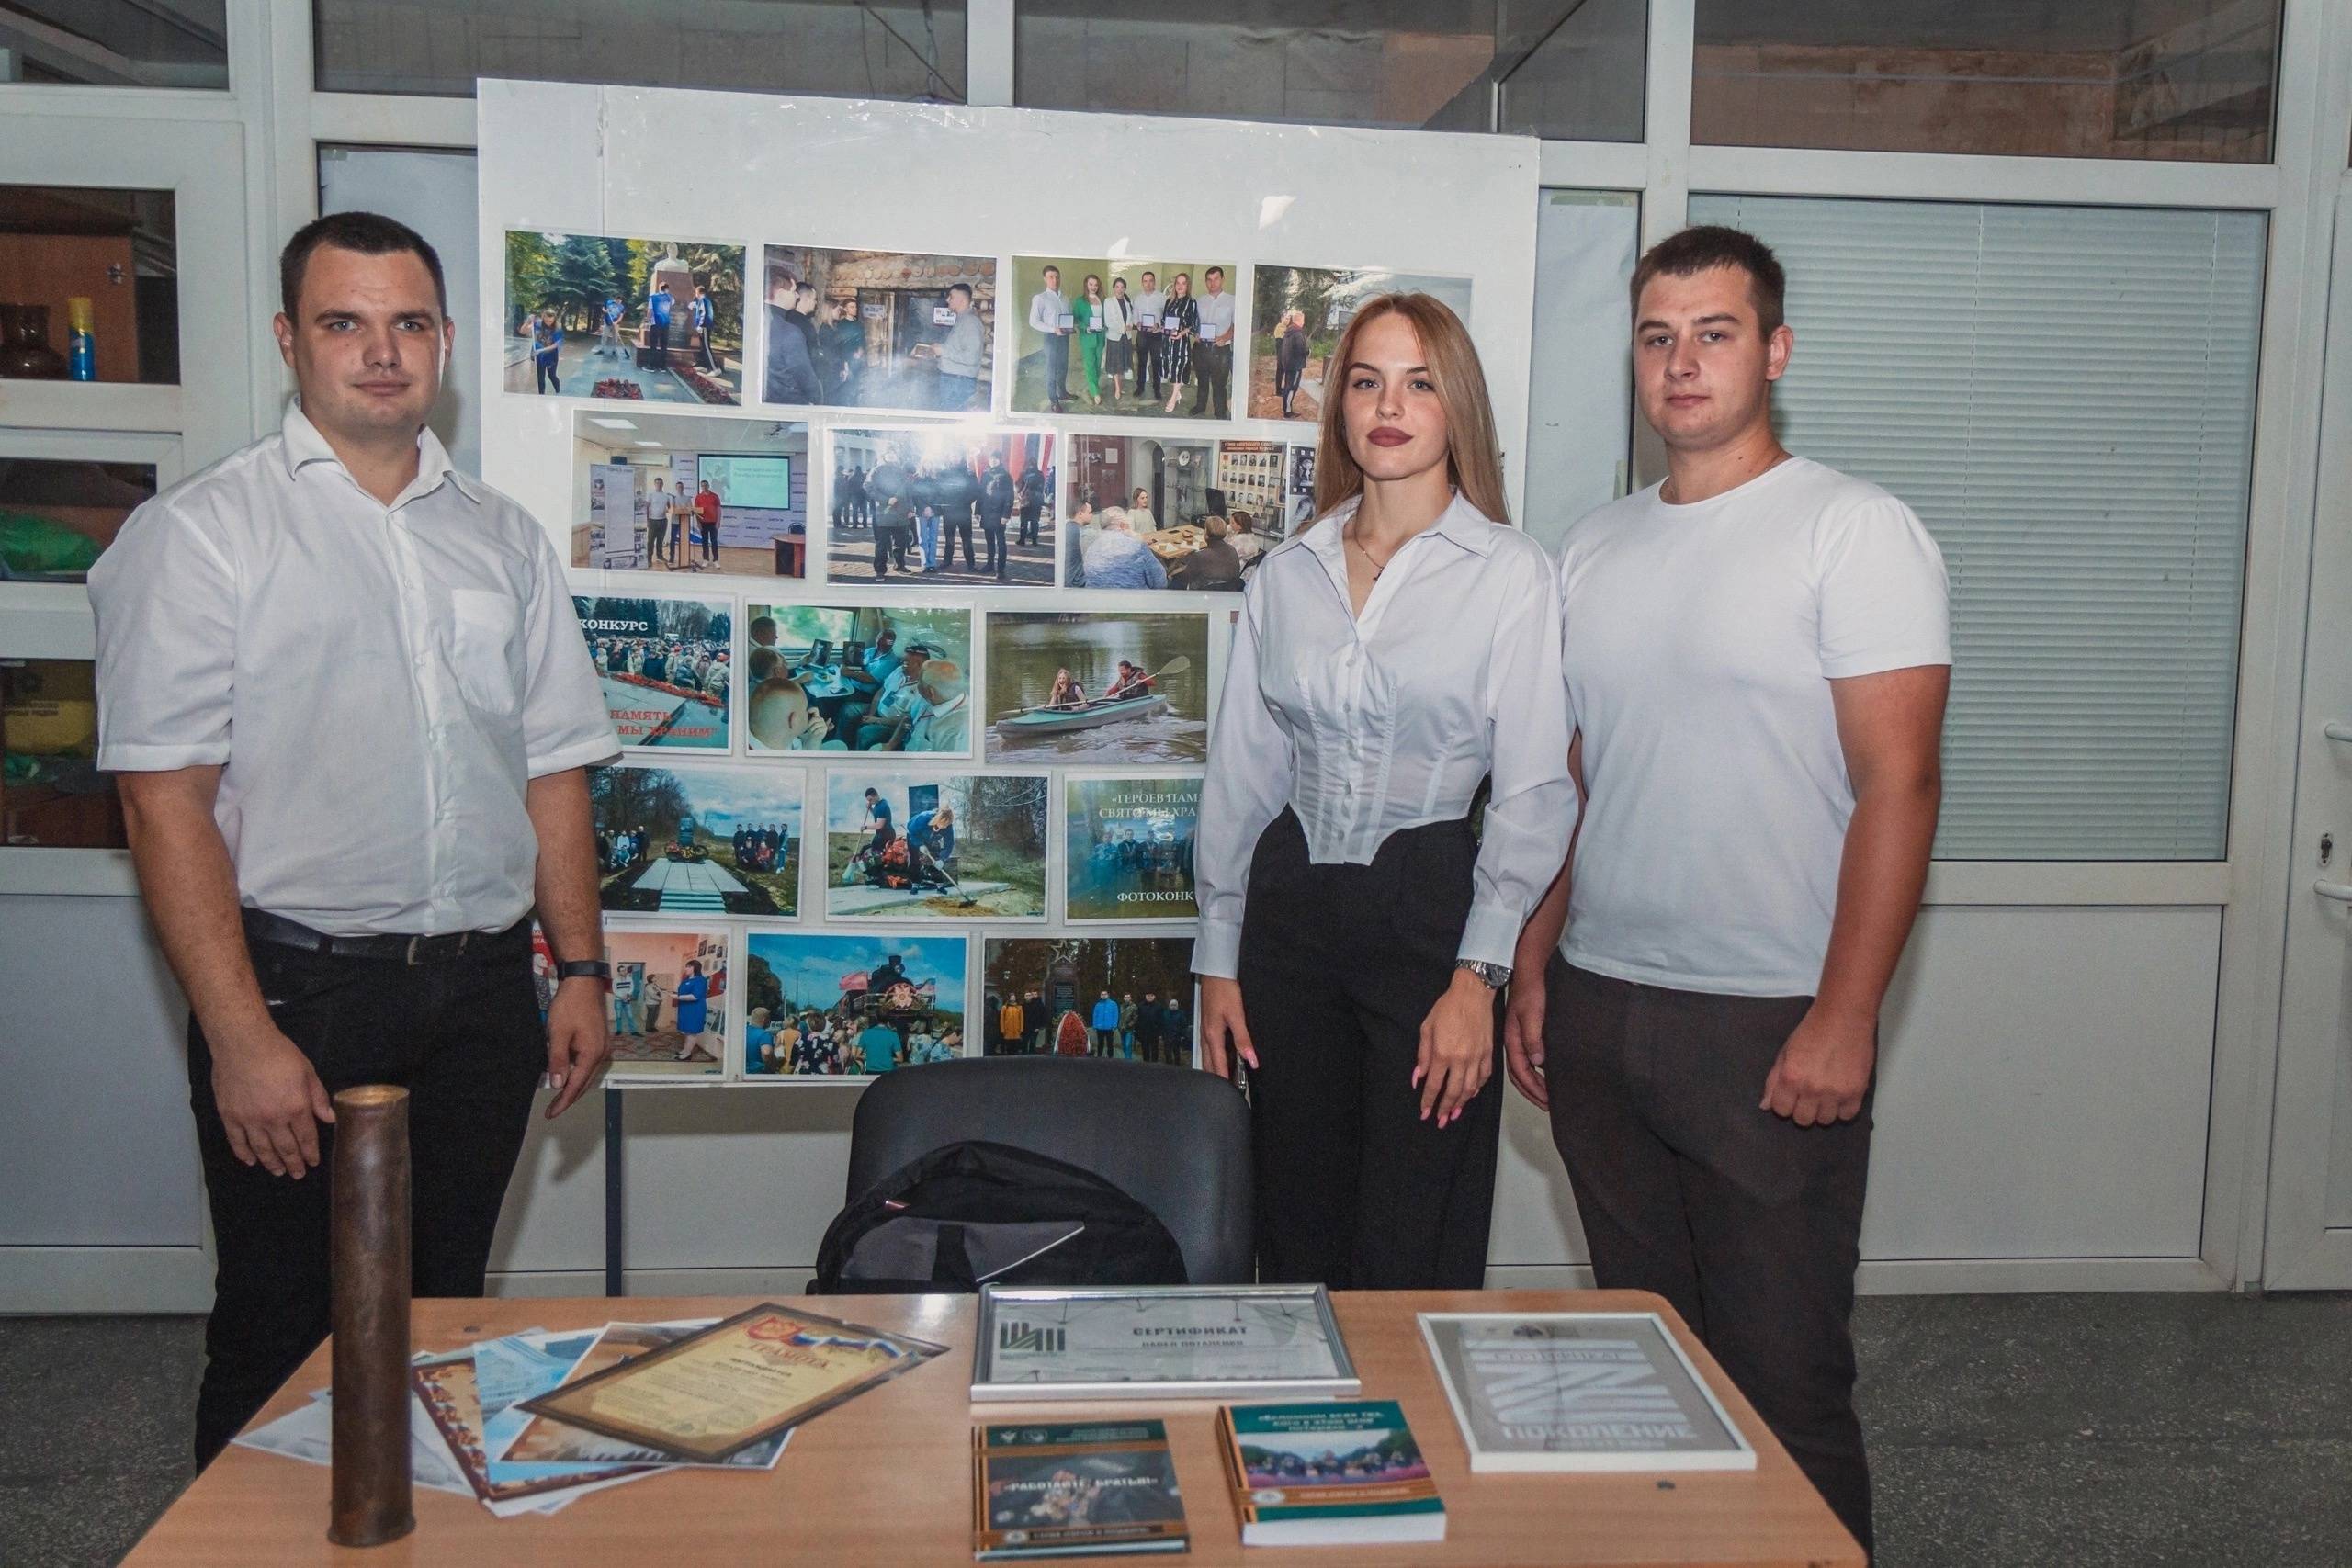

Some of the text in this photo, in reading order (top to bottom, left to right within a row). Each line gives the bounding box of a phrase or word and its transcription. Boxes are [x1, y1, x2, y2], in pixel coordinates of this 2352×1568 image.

[580, 618, 649, 632] КОНКУРС
[610, 709, 671, 721] ПАМЯТЬ
[617, 725, 644, 736] МЫ
[1166, 793, 1202, 803] ПАМ
[1099, 807, 1142, 818] СВЯТО
[1133, 1326, 1247, 1336] СЕРТИФИКАТ
